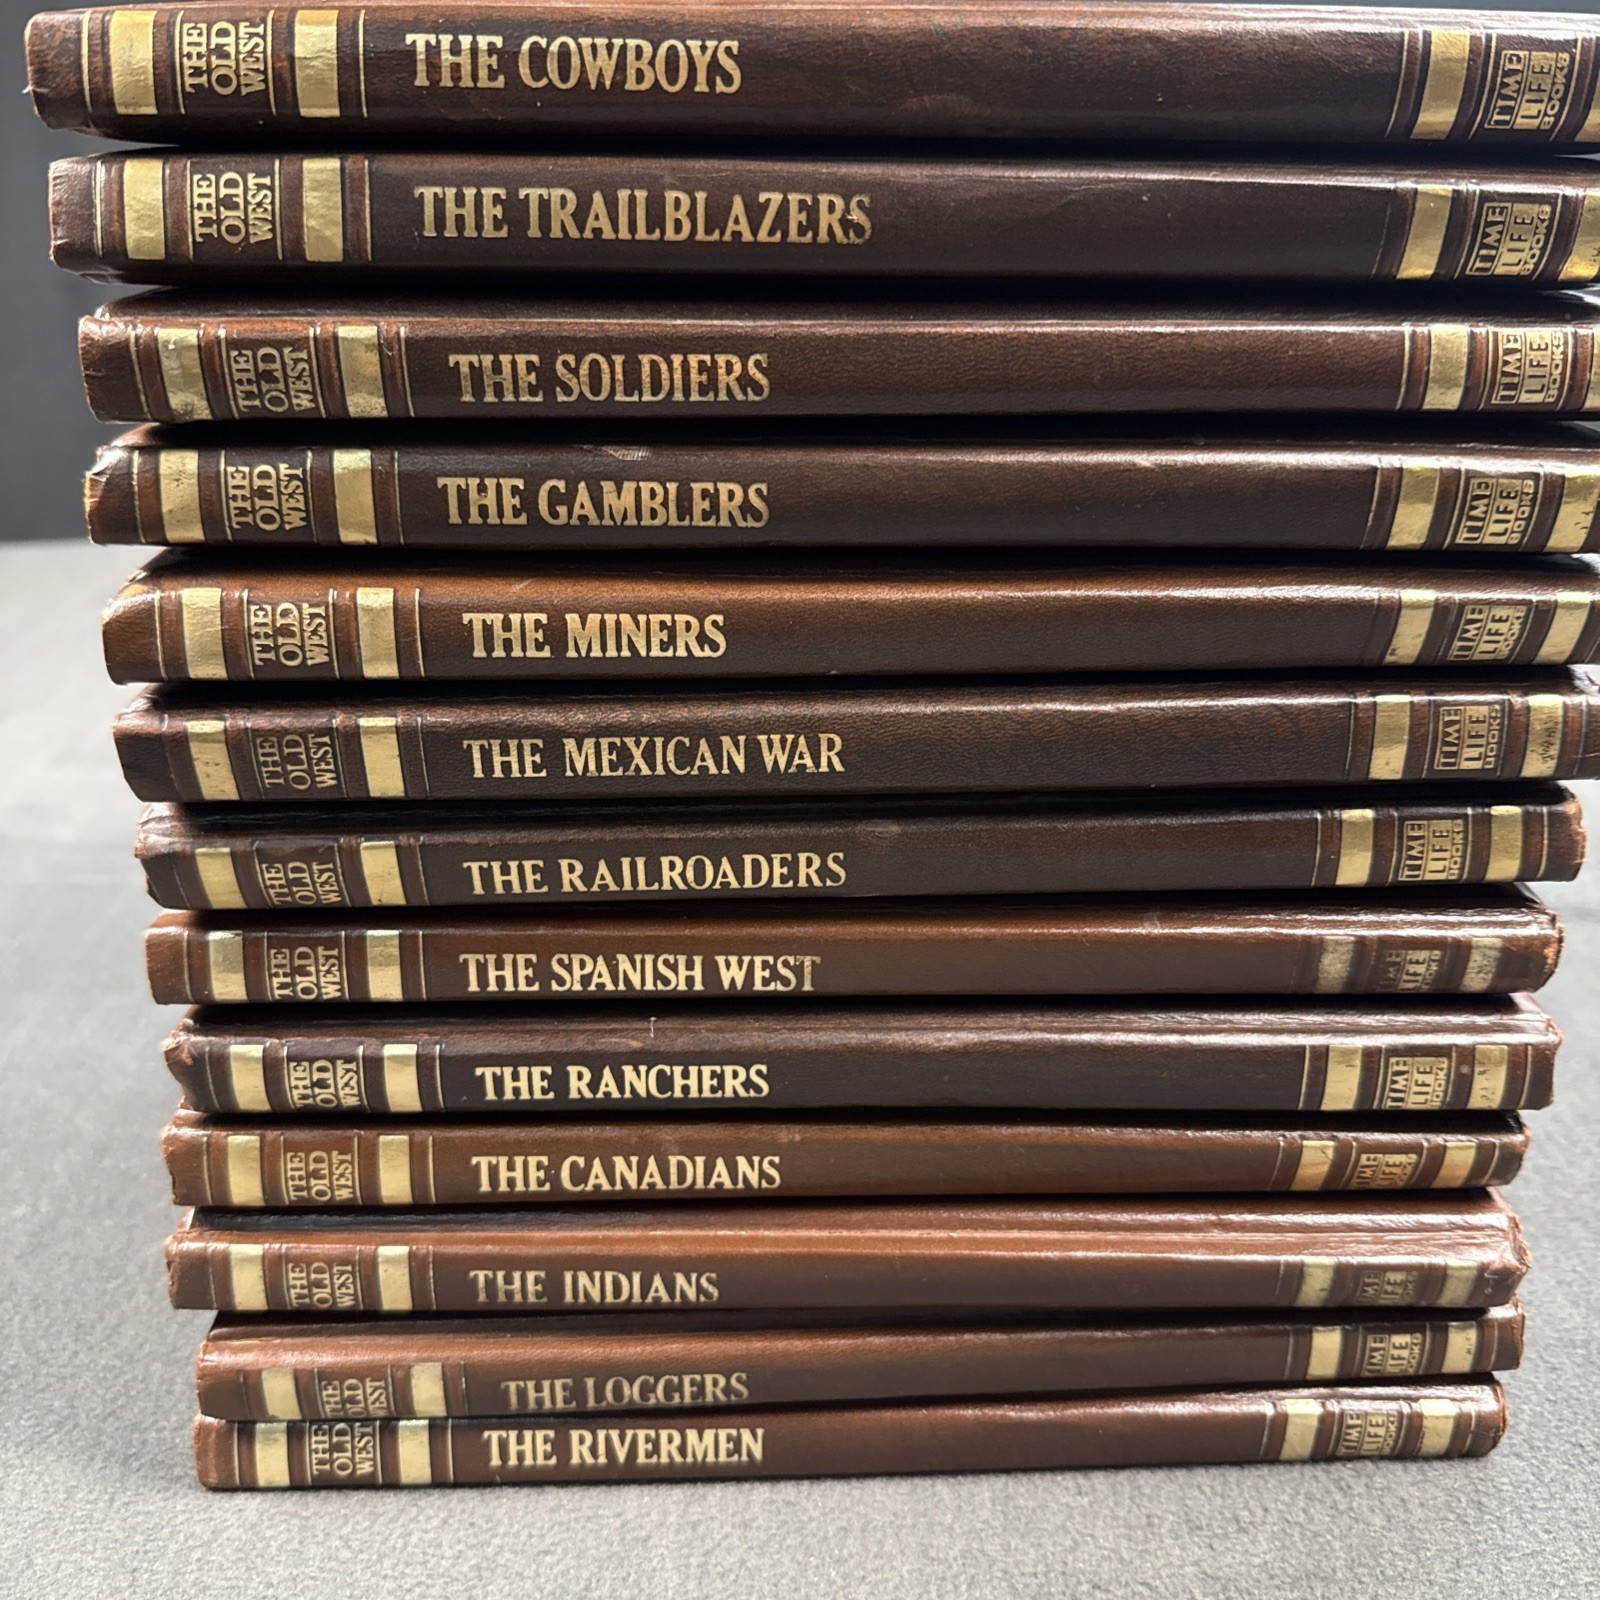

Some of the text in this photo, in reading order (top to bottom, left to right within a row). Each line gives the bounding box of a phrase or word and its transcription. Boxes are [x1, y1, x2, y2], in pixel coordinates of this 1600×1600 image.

[184, 22, 208, 94] THE
[211, 21, 237, 96] OLD
[239, 22, 266, 96] WEST
[404, 32, 742, 94] THE COWBOYS
[1491, 53, 1525, 127] TIME
[1519, 62, 1554, 121] LIFE
[1539, 52, 1571, 130] BOOKS
[193, 173, 218, 242] THE
[220, 171, 246, 244] OLD
[247, 172, 274, 244] WEST
[413, 186, 872, 244] THE TRAILBLAZERS
[1471, 204, 1508, 274] TIME
[1499, 213, 1536, 269] LIFE
[1519, 204, 1552, 275] BOOKS
[231, 349, 259, 412] THE
[258, 347, 289, 413] OLD
[283, 347, 315, 411] WEST
[448, 352, 770, 402] THE SOLDIERS
[1496, 333, 1523, 402] TIME
[1523, 340, 1550, 397] LIFE
[1545, 331, 1564, 402] BOOKS
[226, 466, 254, 529] THE
[253, 465, 282, 531] OLD
[278, 463, 308, 531] WEST
[436, 477, 769, 529] THE GAMBLERS
[1461, 481, 1491, 543] TIME
[1487, 487, 1520, 540] LIFE
[250, 604, 276, 667] THE
[276, 602, 304, 668] OLD
[302, 602, 330, 667] WEST
[461, 612, 727, 659] THE MINERS
[1452, 606, 1484, 660] TIME
[1477, 612, 1511, 656] LIFE
[256, 736, 285, 789] THE
[282, 734, 311, 791] OLD
[308, 733, 338, 789] WEST
[462, 732, 846, 779] THE MEXICAN WAR
[1439, 707, 1463, 770] TIME
[1463, 713, 1487, 763] LIFE
[462, 851, 848, 897] THE RAILROADERS
[1402, 822, 1426, 881] TIME
[1427, 828, 1450, 875] LIFE
[262, 863, 293, 905] THE
[287, 861, 317, 906] OLD
[312, 861, 342, 905] WEST
[270, 948, 294, 1000] THE
[294, 946, 318, 1000] OLD
[317, 945, 342, 1000] WEST
[459, 953, 822, 992] THE SPANISH WEST
[289, 1061, 315, 1107] THE
[312, 1059, 338, 1108] OLD
[336, 1059, 361, 1107] WEST
[474, 1063, 770, 1101] THE RANCHERS
[1410, 1064, 1434, 1106] LIFE
[286, 1152, 308, 1201] THE
[309, 1150, 331, 1201] OLD
[332, 1150, 354, 1200] WEST
[470, 1154, 782, 1192] THE CANADIANS
[288, 1263, 310, 1307] THE
[311, 1262, 333, 1309] OLD
[333, 1262, 356, 1308] WEST
[469, 1269, 720, 1304] THE INDIANS
[343, 1378, 366, 1418] OLD
[501, 1371, 751, 1410] THE LOGGERS
[311, 1424, 330, 1475] THE
[333, 1422, 353, 1476] OLD
[354, 1422, 375, 1475] WEST
[482, 1427, 766, 1469] THE RIVERMEN
[1362, 1418, 1386, 1453] LIFE
